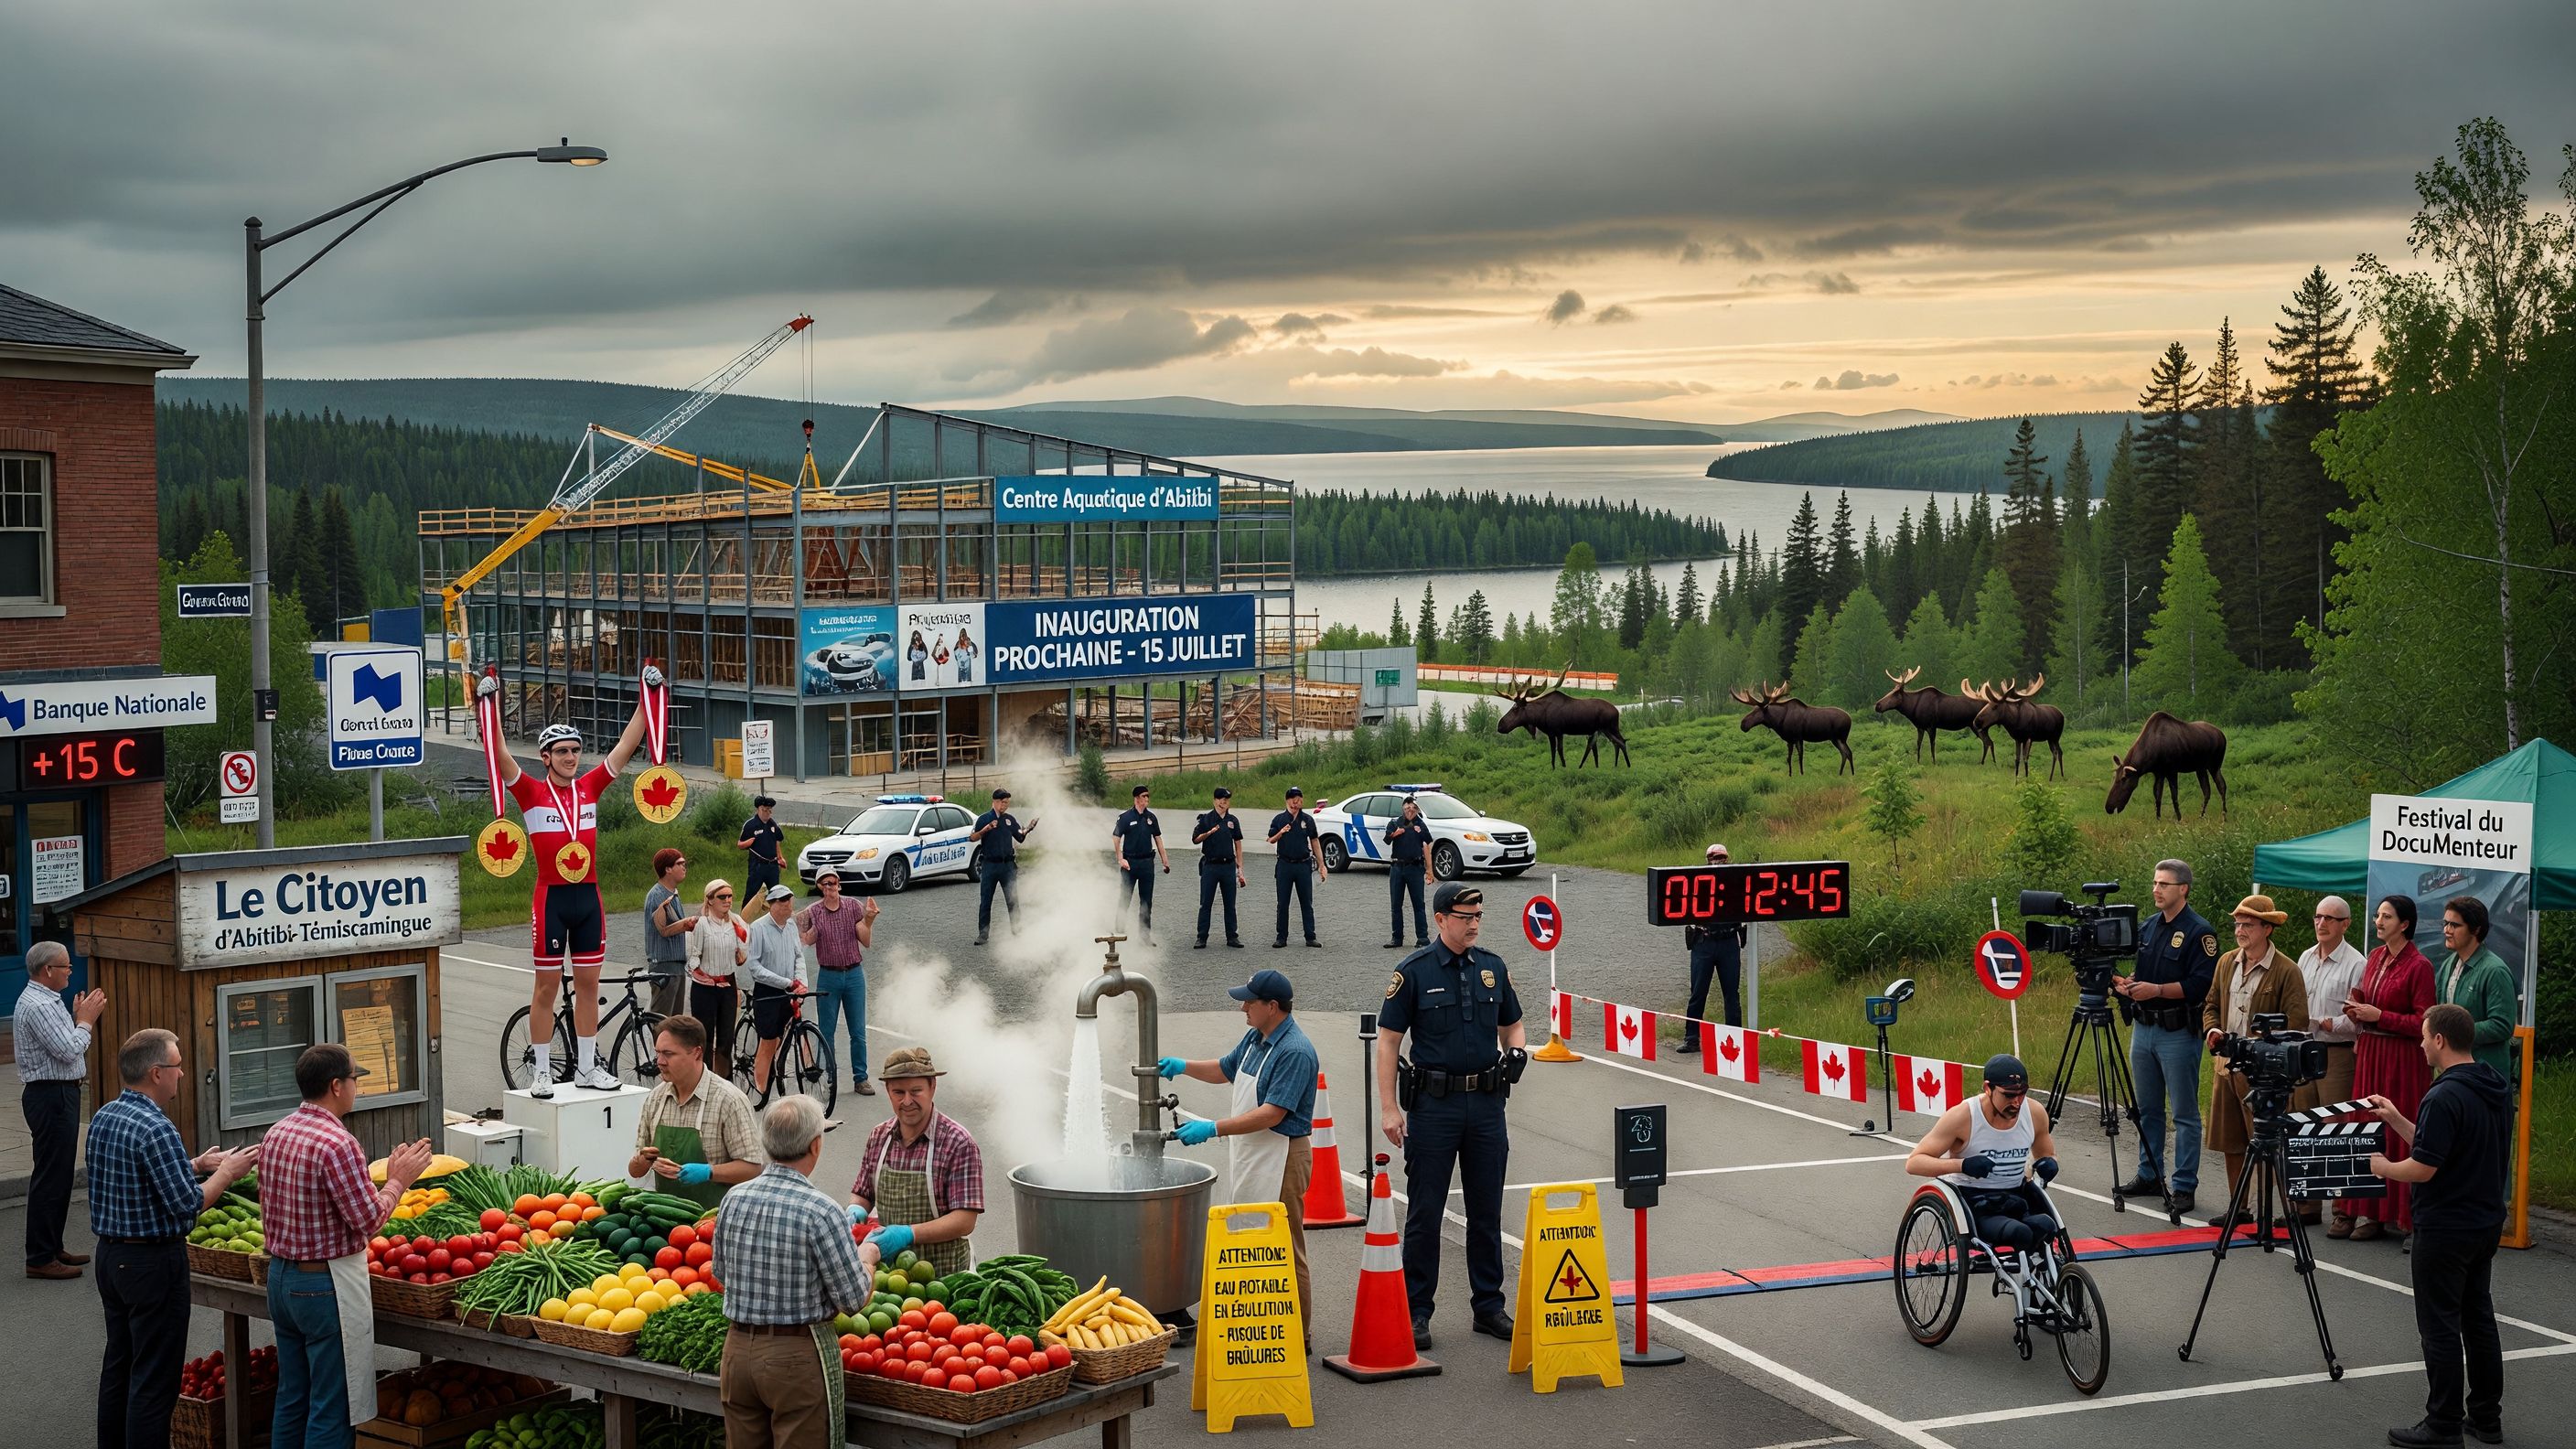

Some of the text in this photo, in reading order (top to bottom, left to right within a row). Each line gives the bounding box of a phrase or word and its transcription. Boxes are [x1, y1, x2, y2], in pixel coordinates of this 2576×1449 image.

[1002, 487, 1058, 509] Centre
[1062, 487, 1146, 513] Aquatique
[1035, 605, 1199, 638] INAUGURATION
[994, 639, 1122, 671] PROCHAINE
[1141, 638, 1164, 663] 15
[1167, 634, 1247, 662] JUILLET
[33, 691, 207, 724] Banque Nationale
[33, 738, 135, 780] +15 C
[2398, 805, 2504, 832] Festival du
[2382, 830, 2518, 860] DocuMenteur
[215, 871, 428, 921] Le Citoyen
[603, 1106, 612, 1129] 1
[1271, 1324, 1285, 1340] DE
